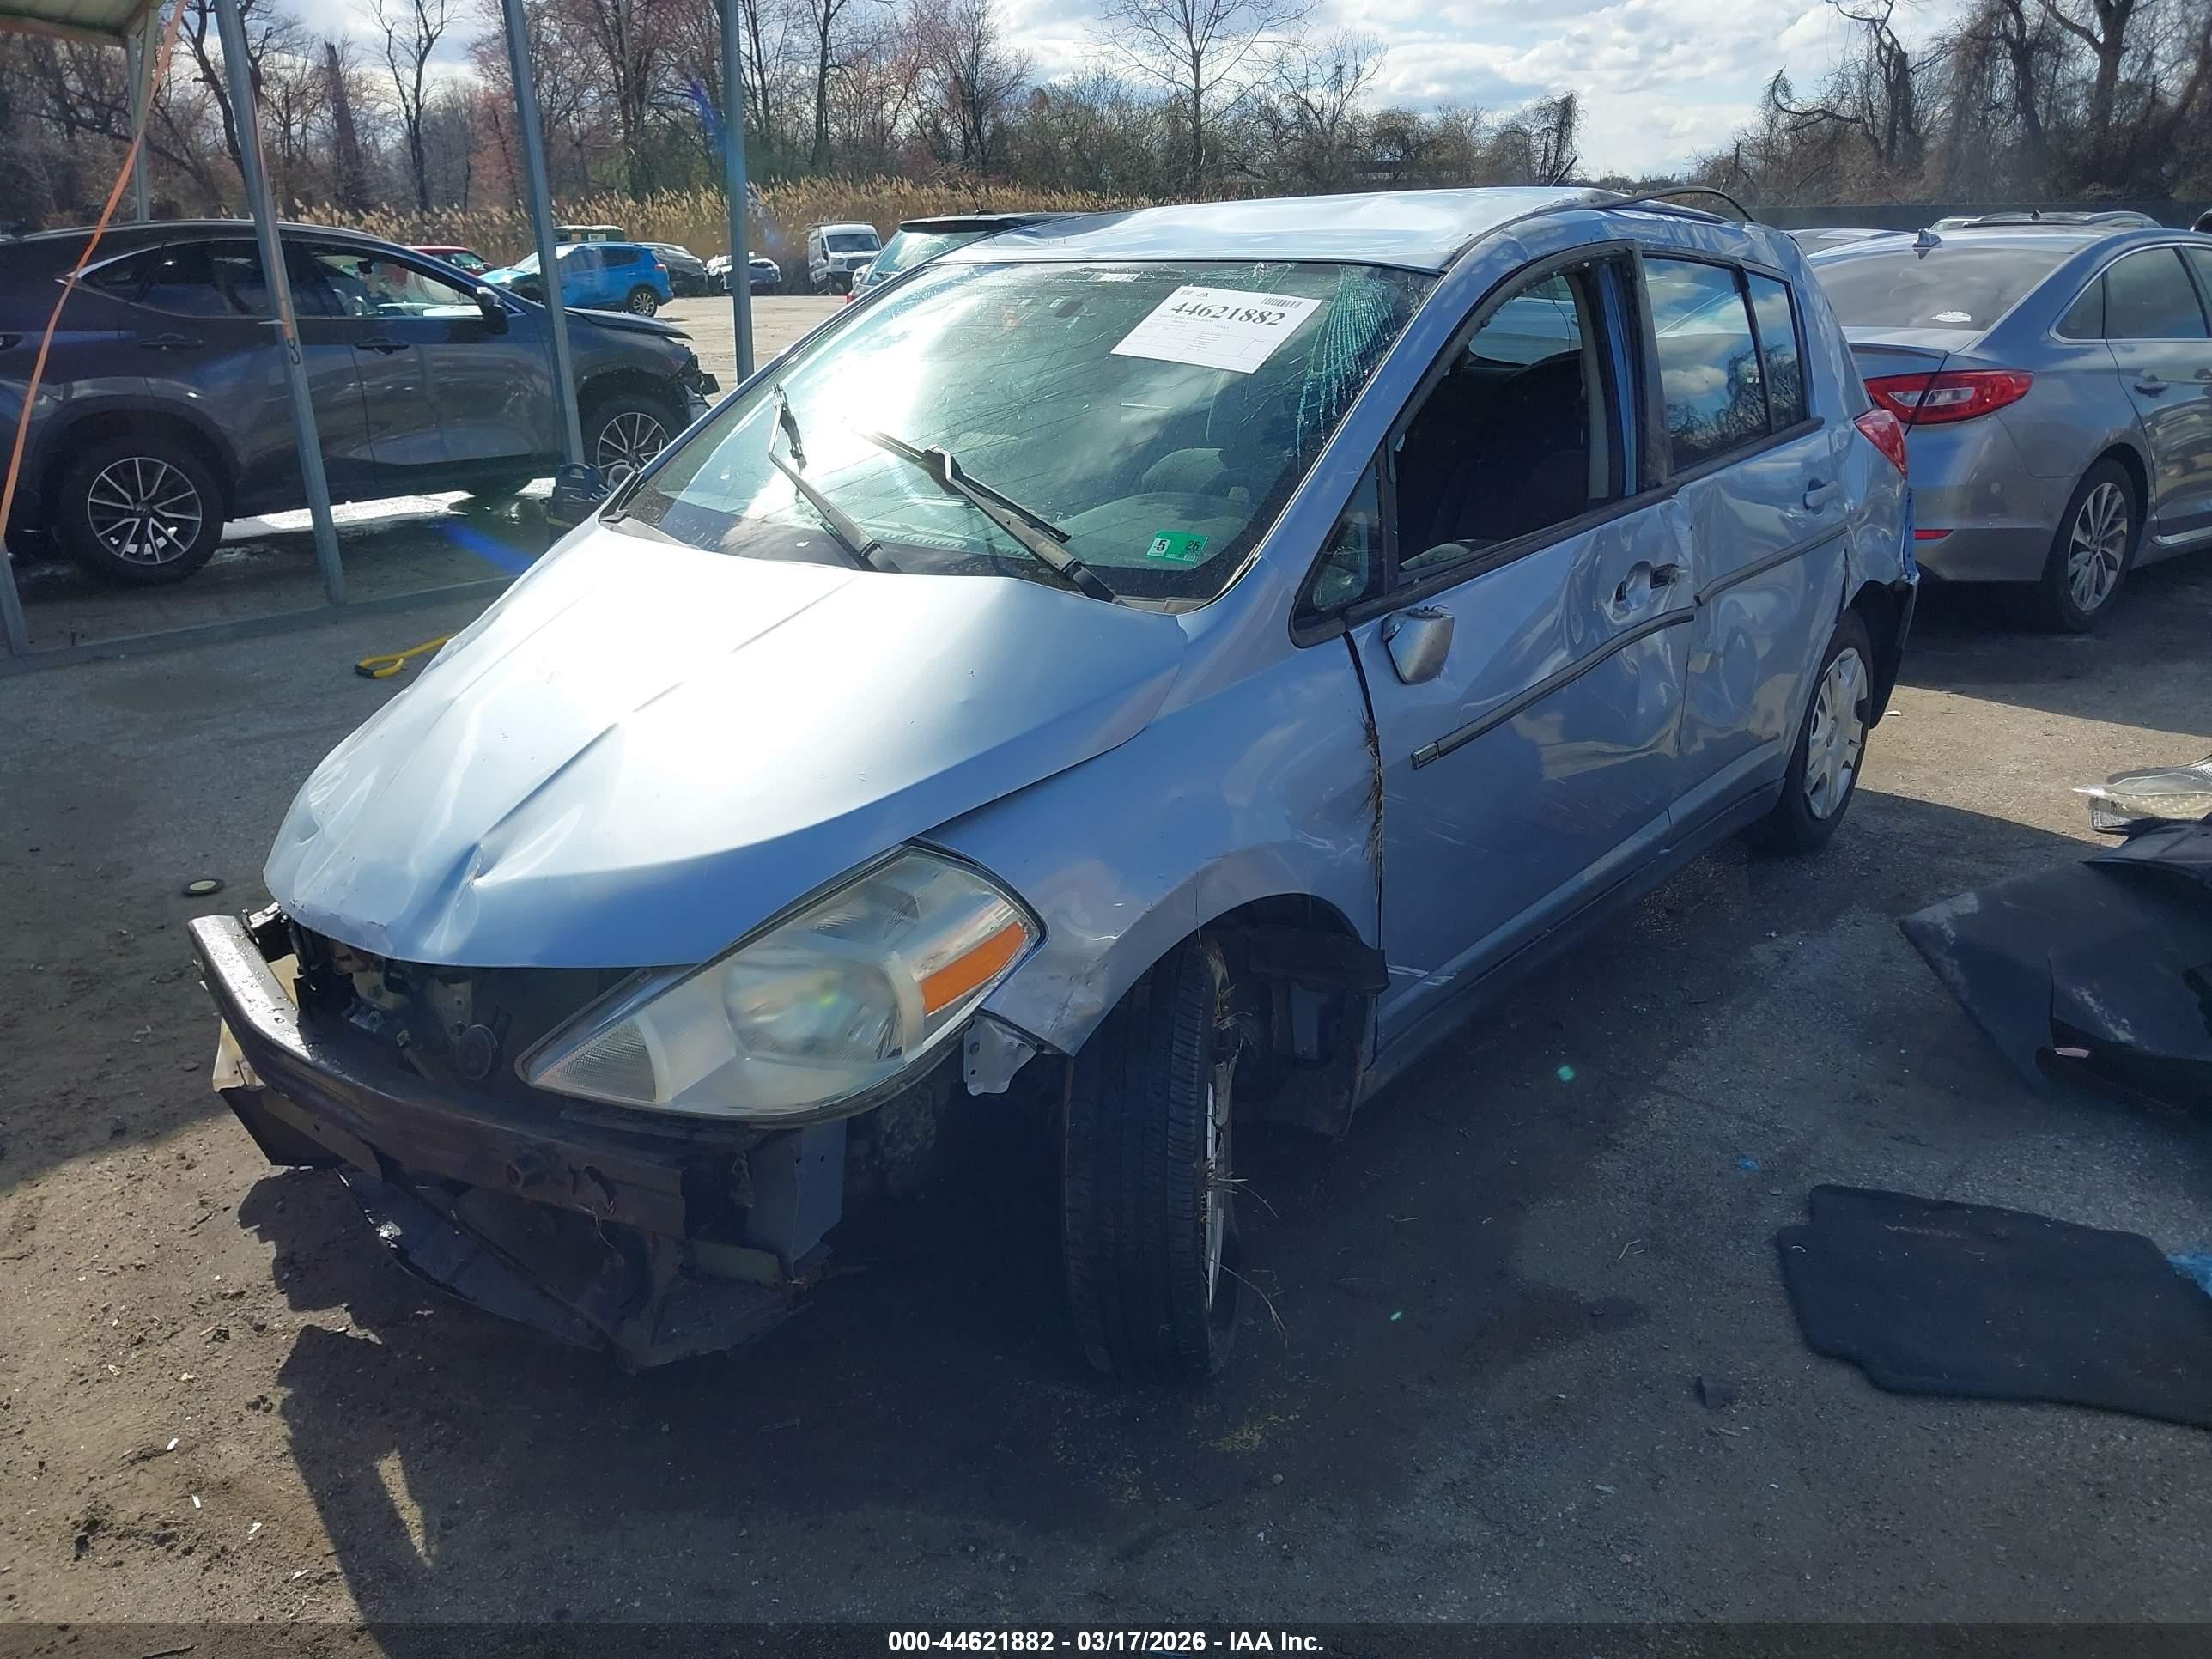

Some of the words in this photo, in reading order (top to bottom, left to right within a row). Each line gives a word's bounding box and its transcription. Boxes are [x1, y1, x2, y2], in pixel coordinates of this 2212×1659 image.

[1170, 301, 1286, 326] 44621882
[1156, 539, 1168, 551] 5
[1185, 540, 1201, 551] 26
